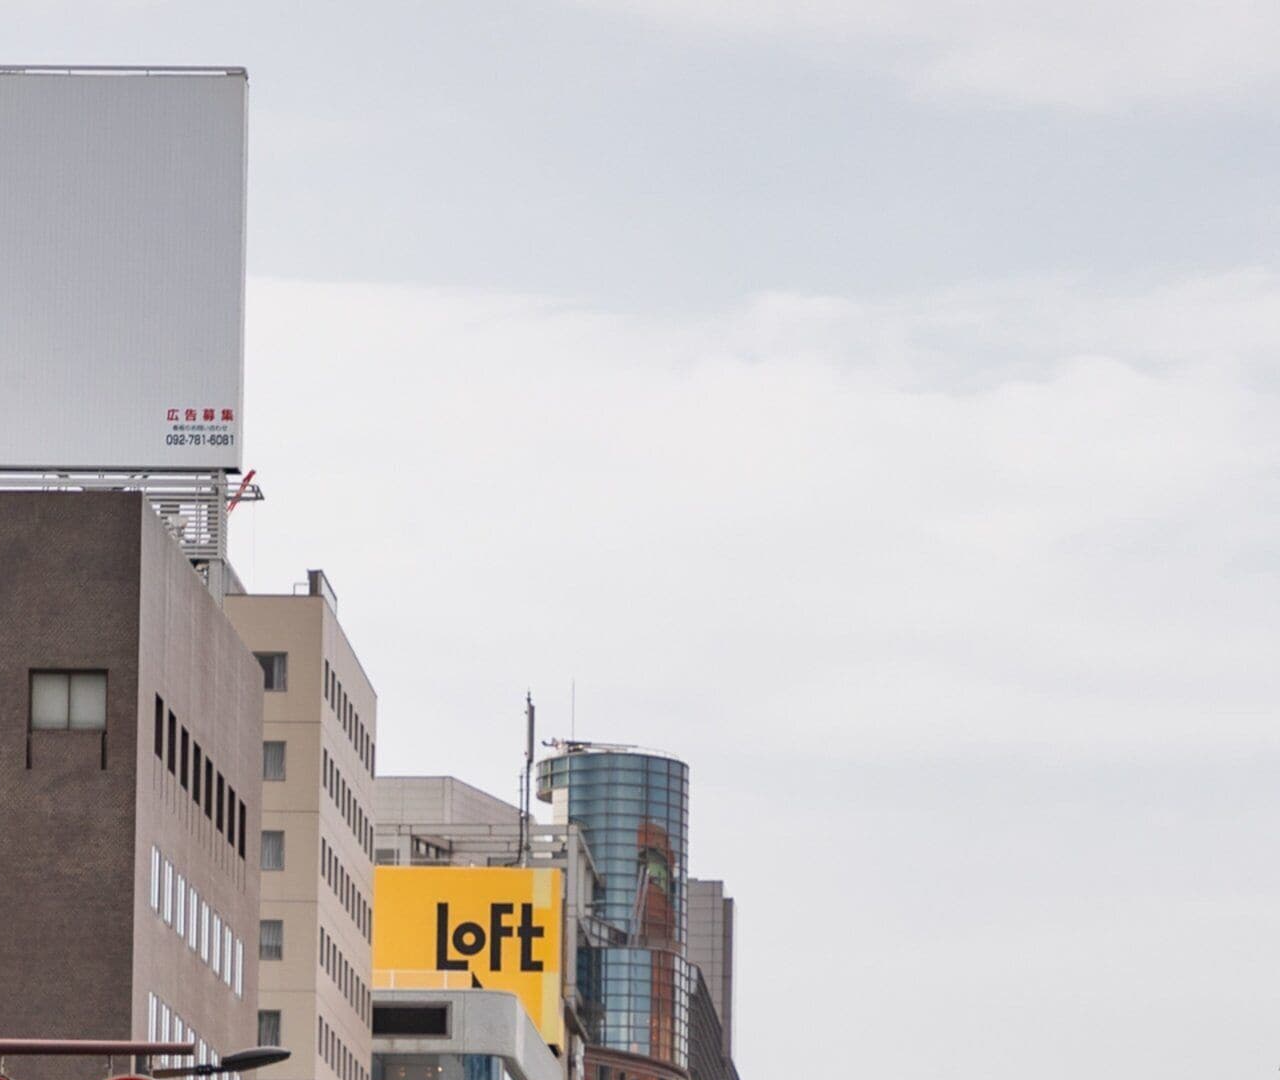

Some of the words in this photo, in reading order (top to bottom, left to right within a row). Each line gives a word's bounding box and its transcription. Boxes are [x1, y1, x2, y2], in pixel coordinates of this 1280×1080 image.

[166, 407, 234, 421] 広告募集
[166, 433, 234, 446] 092-781-6081
